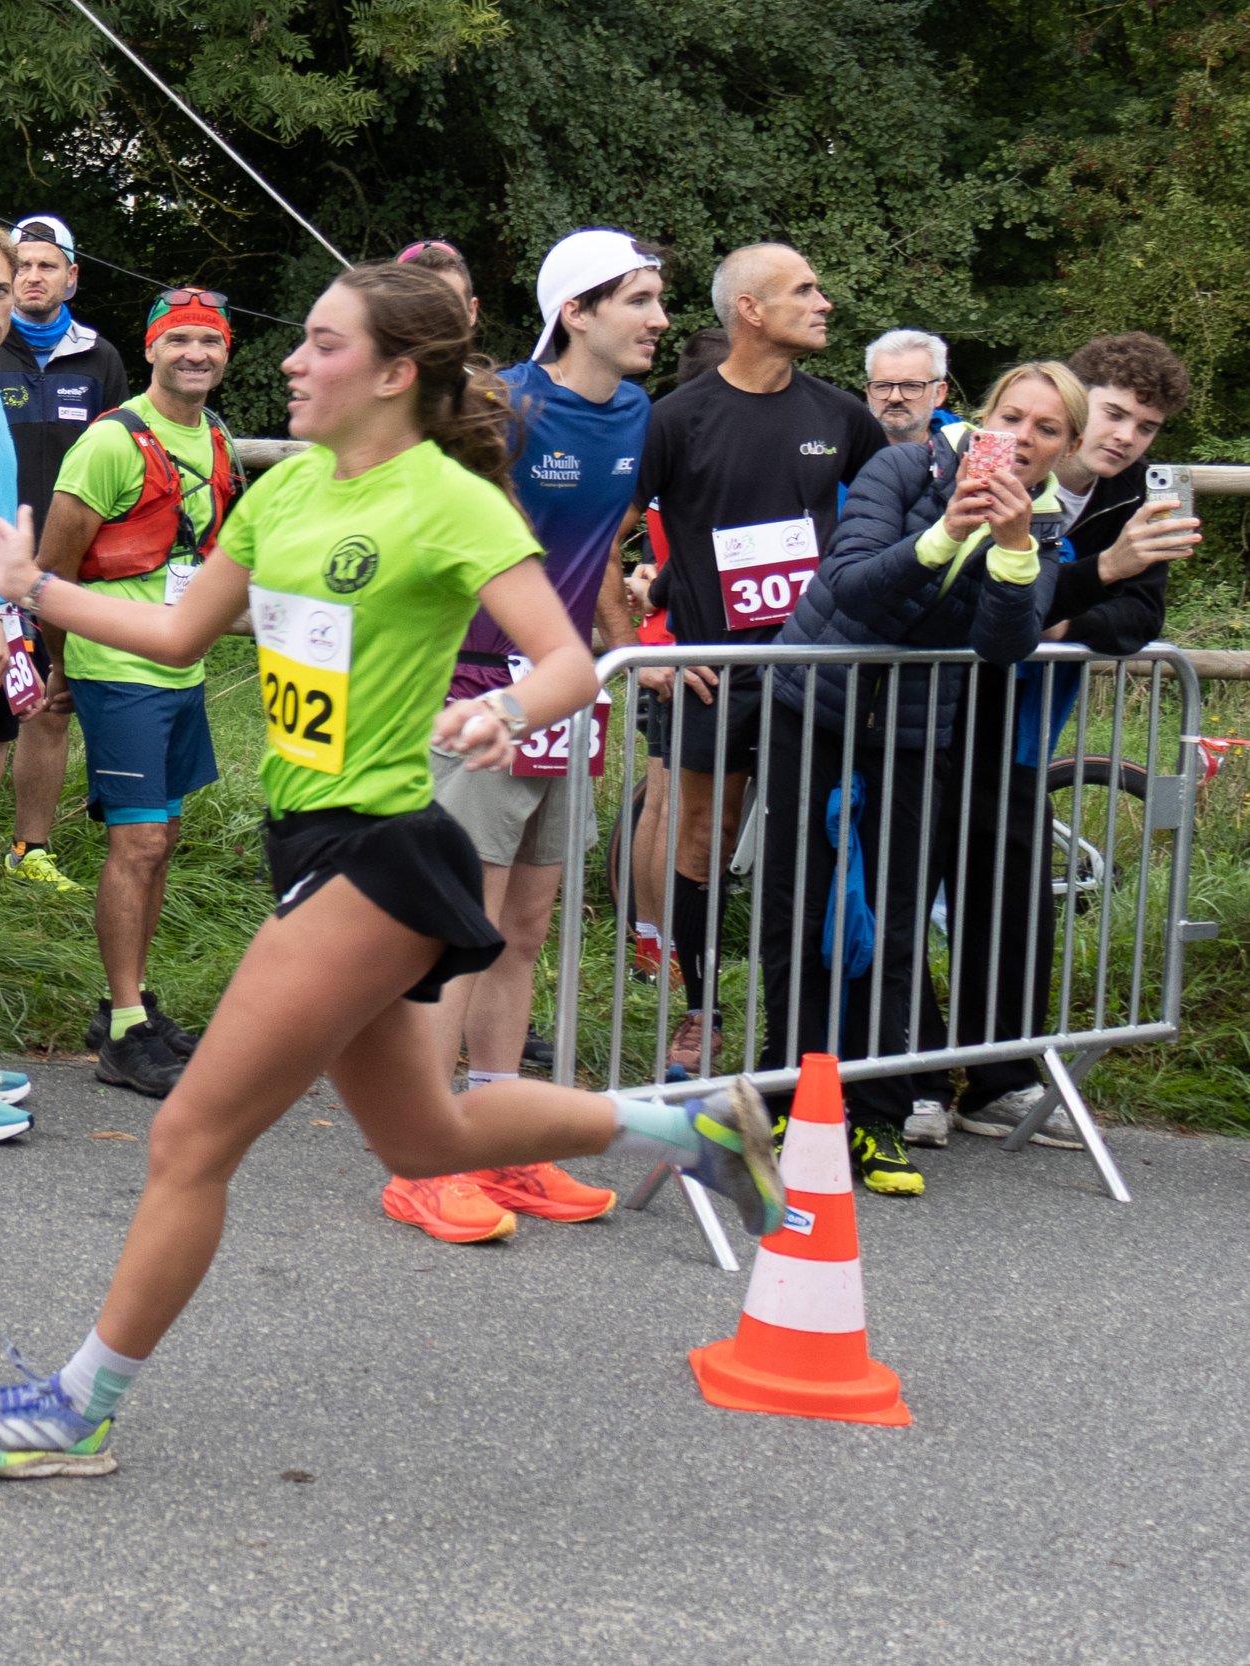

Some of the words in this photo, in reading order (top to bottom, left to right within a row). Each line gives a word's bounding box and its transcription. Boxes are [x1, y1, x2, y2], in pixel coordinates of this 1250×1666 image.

[530, 465, 581, 480] Sancerre
[731, 569, 815, 614] 307
[265, 672, 334, 745] 202
